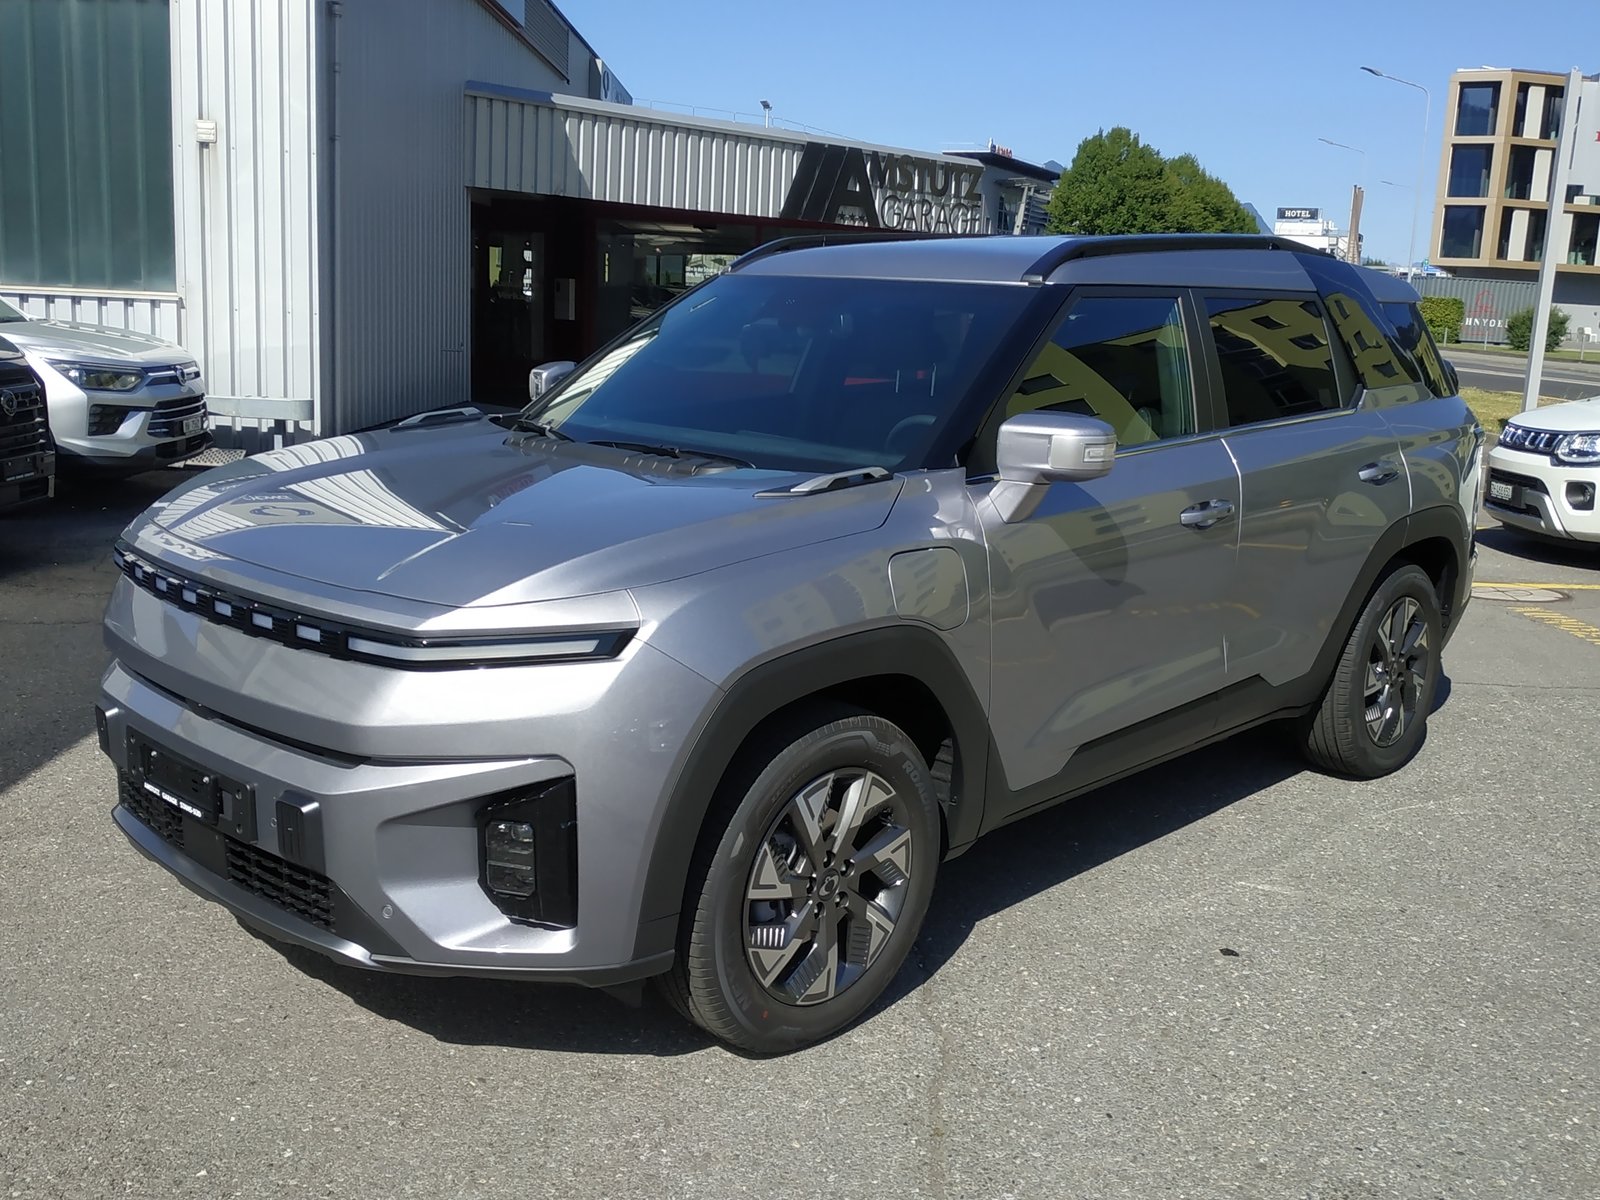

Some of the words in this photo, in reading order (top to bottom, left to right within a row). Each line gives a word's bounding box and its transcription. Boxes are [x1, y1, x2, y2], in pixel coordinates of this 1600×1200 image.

[821, 146, 984, 228] AMSTUTZ
[881, 195, 981, 235] GARAGE
[1284, 210, 1311, 218] HOTEL
[1462, 317, 1510, 329] HNYDE
